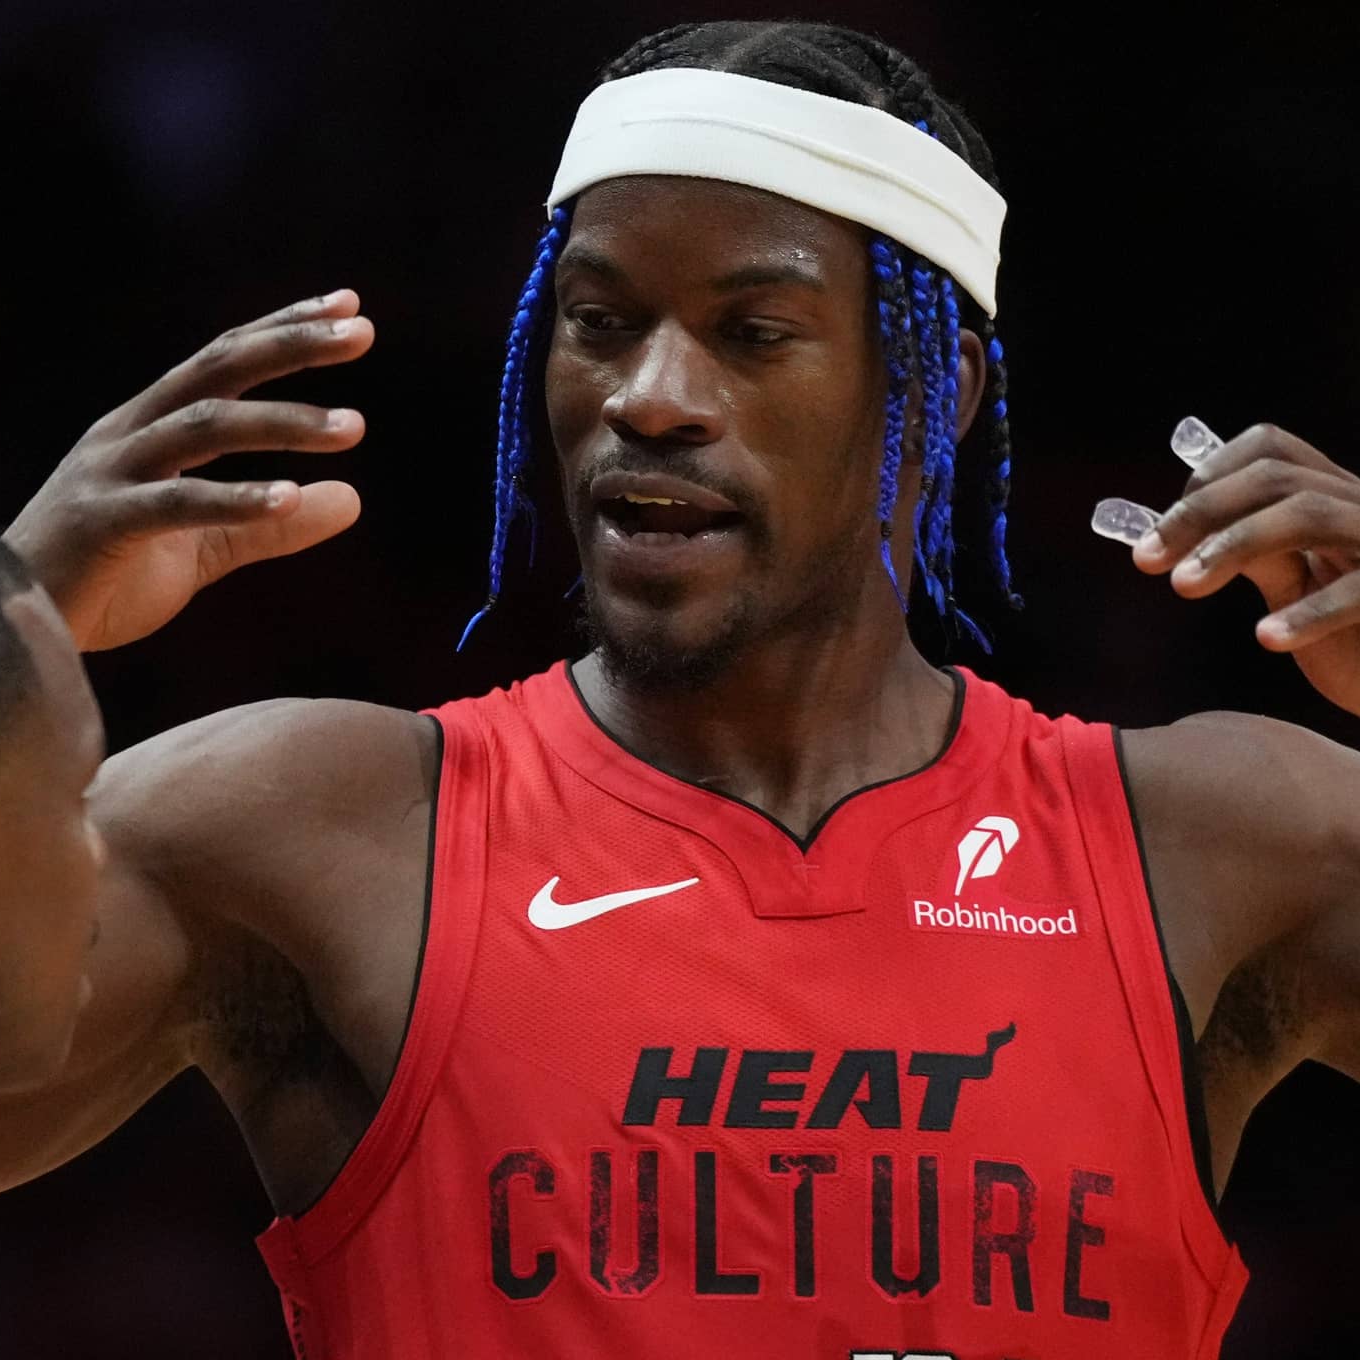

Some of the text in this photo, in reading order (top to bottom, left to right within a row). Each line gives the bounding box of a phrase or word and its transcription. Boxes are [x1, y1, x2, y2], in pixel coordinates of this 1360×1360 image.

[914, 901, 1078, 935] Robinhood
[622, 1021, 1017, 1131] HEAT
[486, 1146, 1116, 1321] CULTURE
